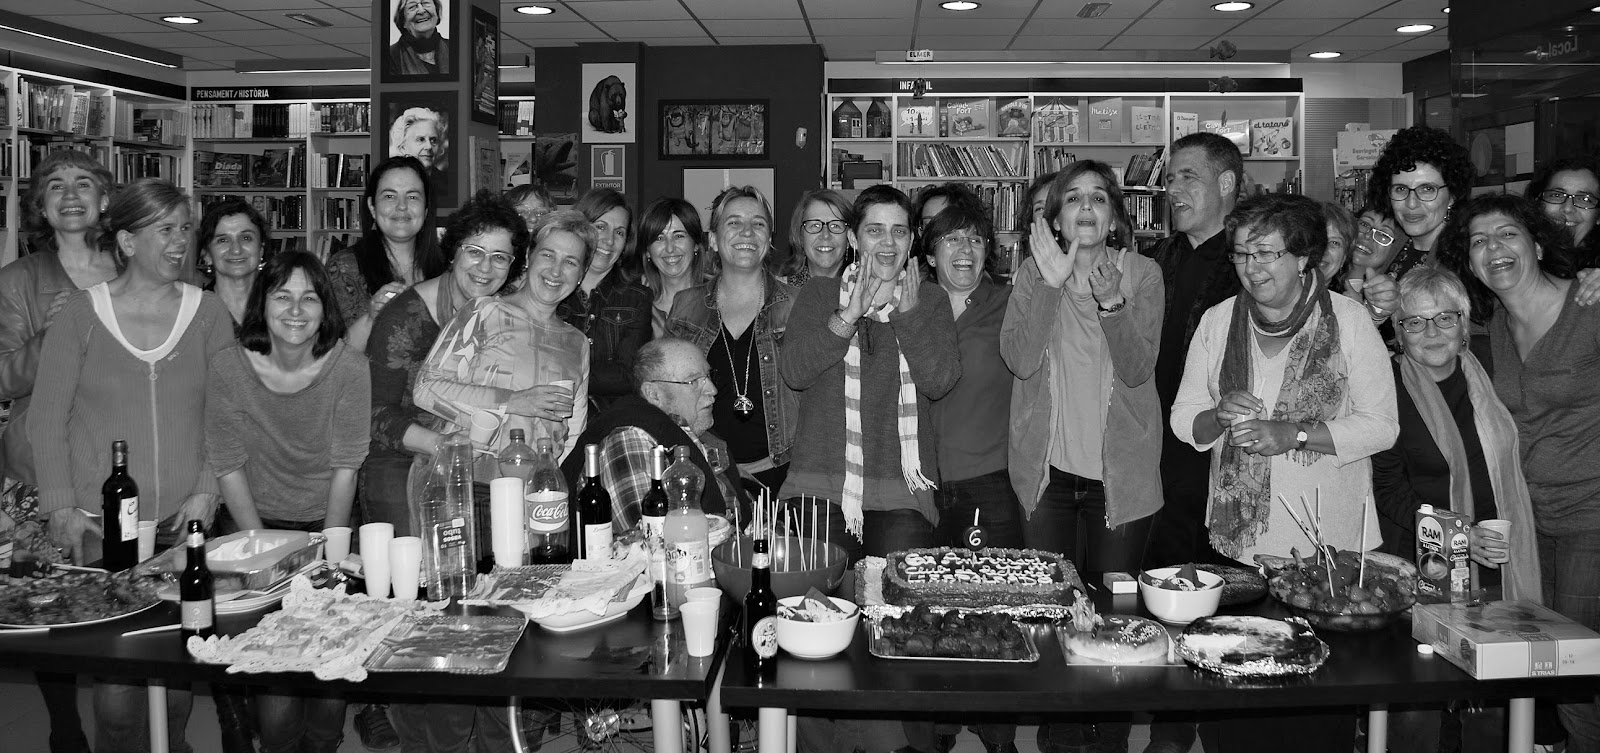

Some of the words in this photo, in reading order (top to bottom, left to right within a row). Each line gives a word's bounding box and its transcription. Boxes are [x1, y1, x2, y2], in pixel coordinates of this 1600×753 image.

[899, 80, 933, 90] INFAIL
[214, 162, 242, 170] Diada
[968, 529, 982, 547] 6
[1421, 526, 1441, 541] RAM
